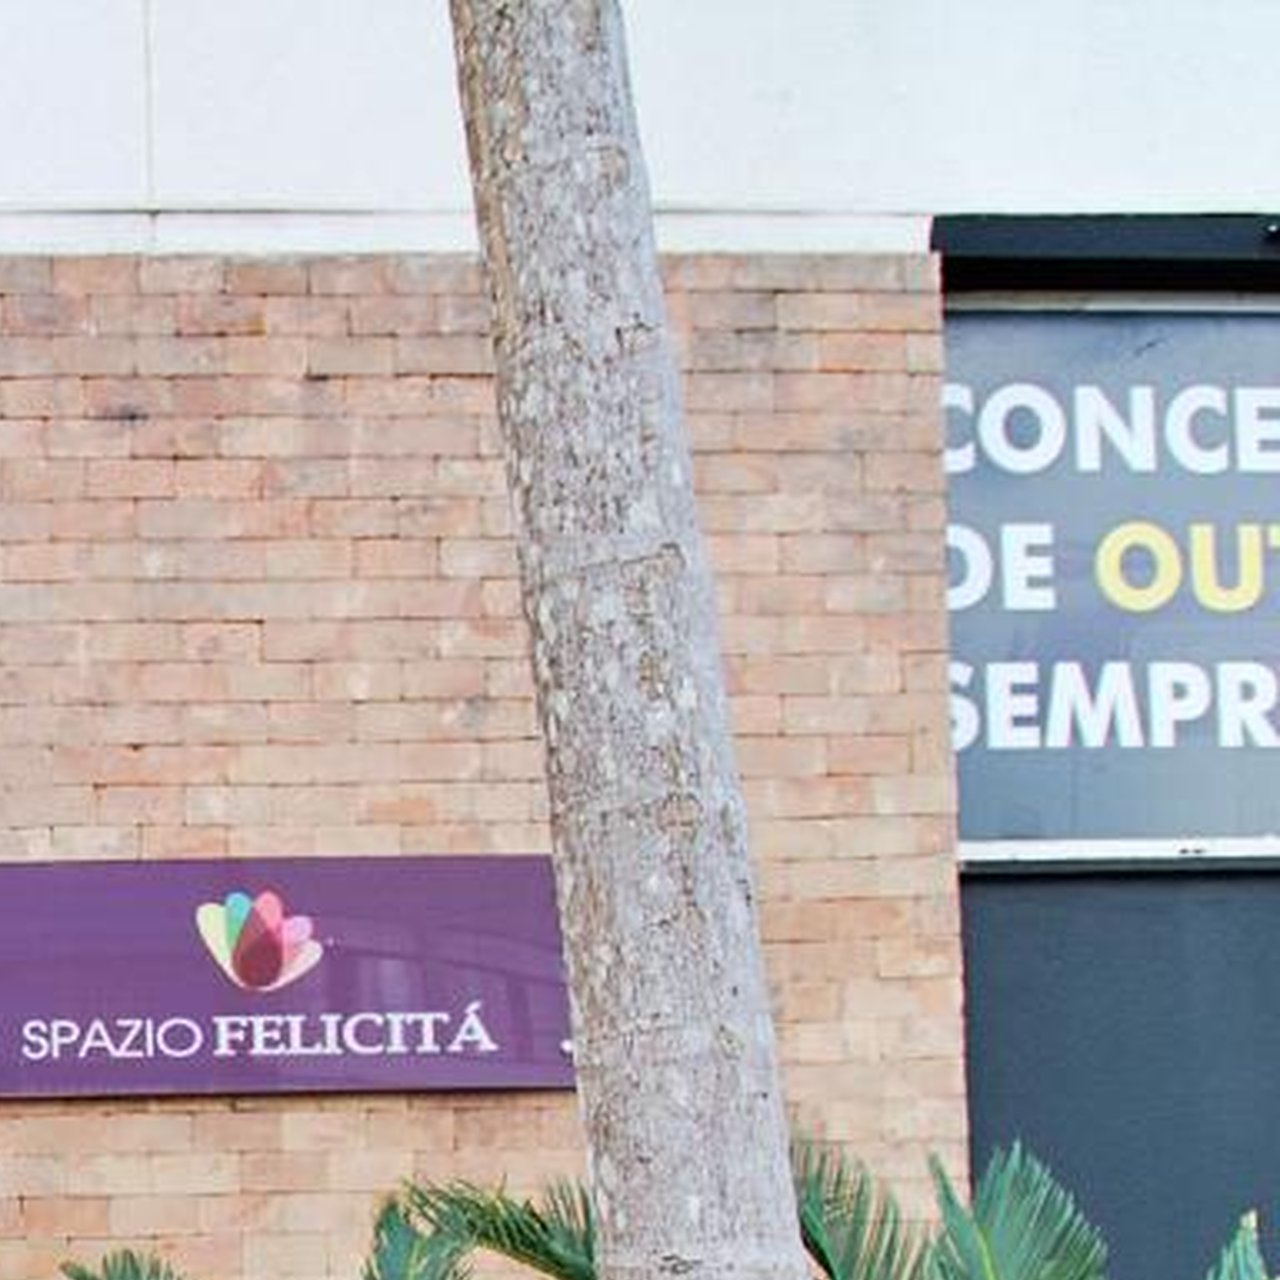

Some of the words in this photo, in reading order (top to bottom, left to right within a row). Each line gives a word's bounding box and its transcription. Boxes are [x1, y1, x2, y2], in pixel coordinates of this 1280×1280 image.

[946, 523, 1056, 611] DE
[1096, 522, 1280, 612] OU
[22, 1018, 203, 1058] SPAZIO
[213, 1002, 497, 1056] FELICITÁ
